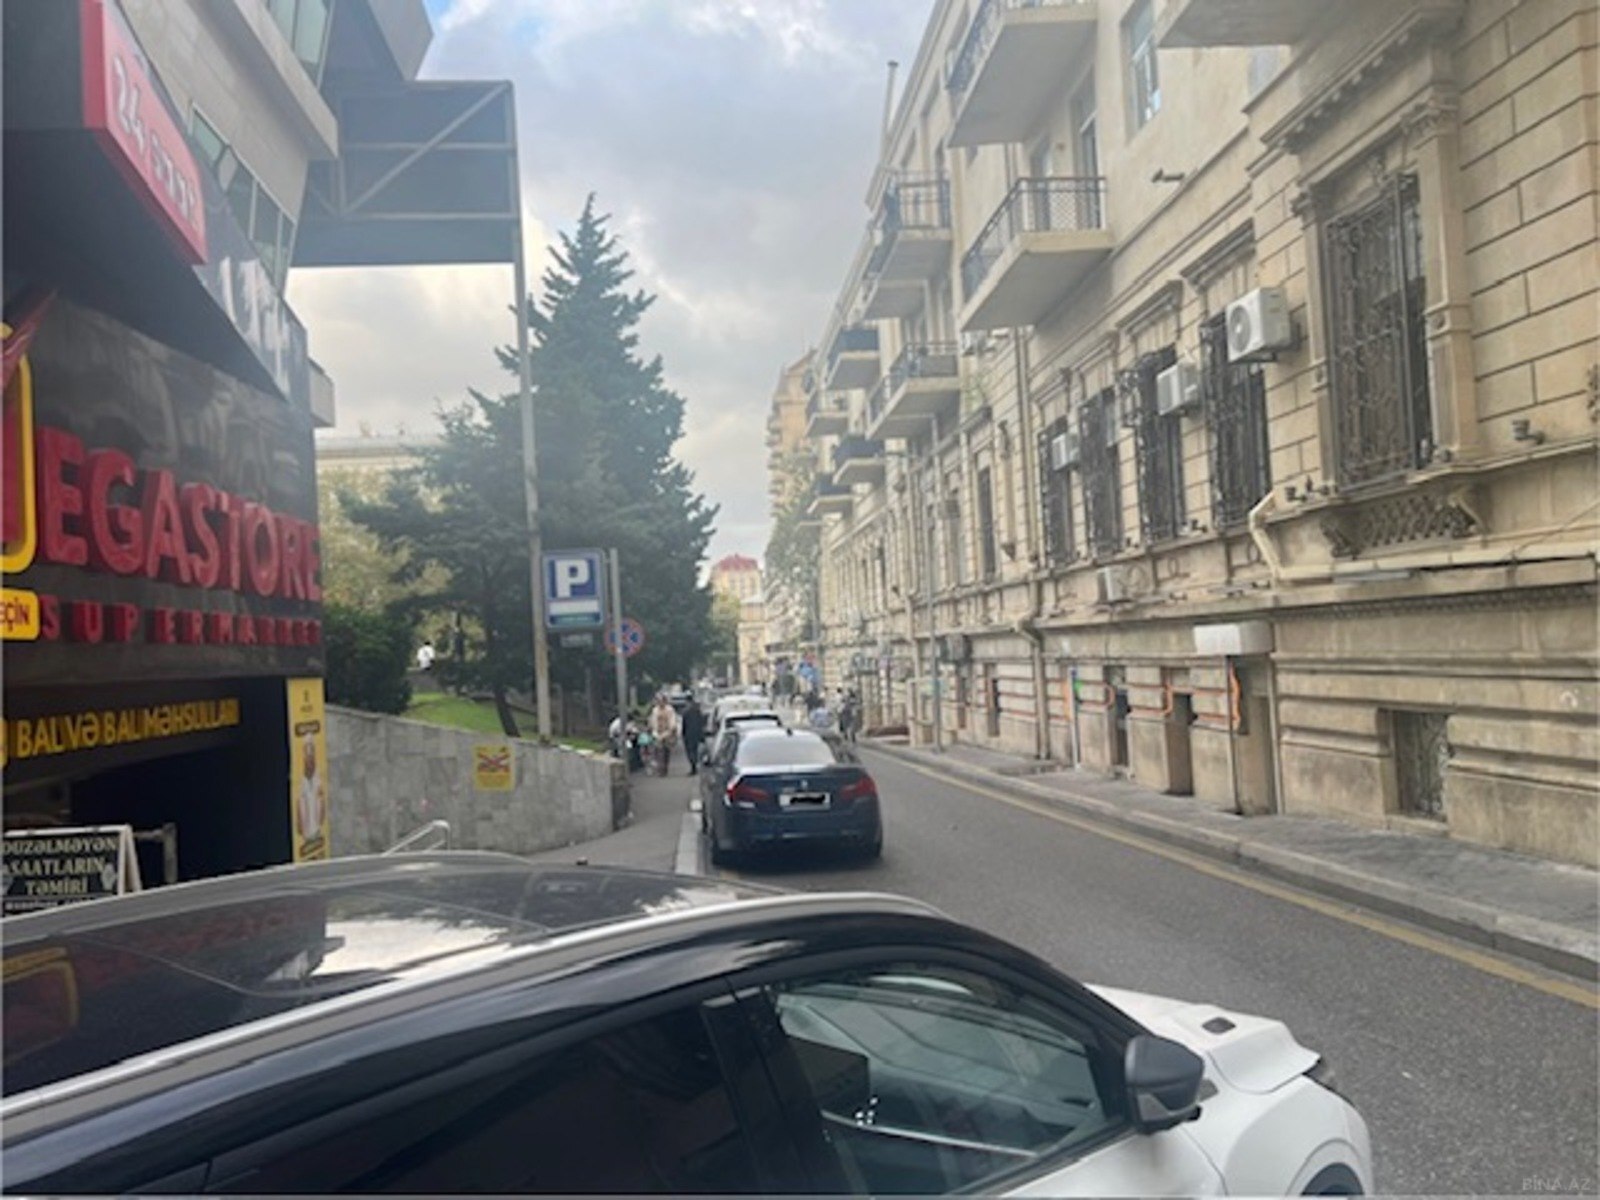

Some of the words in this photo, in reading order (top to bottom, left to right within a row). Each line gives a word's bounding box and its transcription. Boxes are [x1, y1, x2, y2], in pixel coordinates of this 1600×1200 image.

[554, 558, 589, 598] P
[13, 716, 66, 759] BAL
[65, 711, 99, 750] VƏ
[102, 710, 141, 746] BAL
[142, 698, 240, 738] MƏHSULLA
